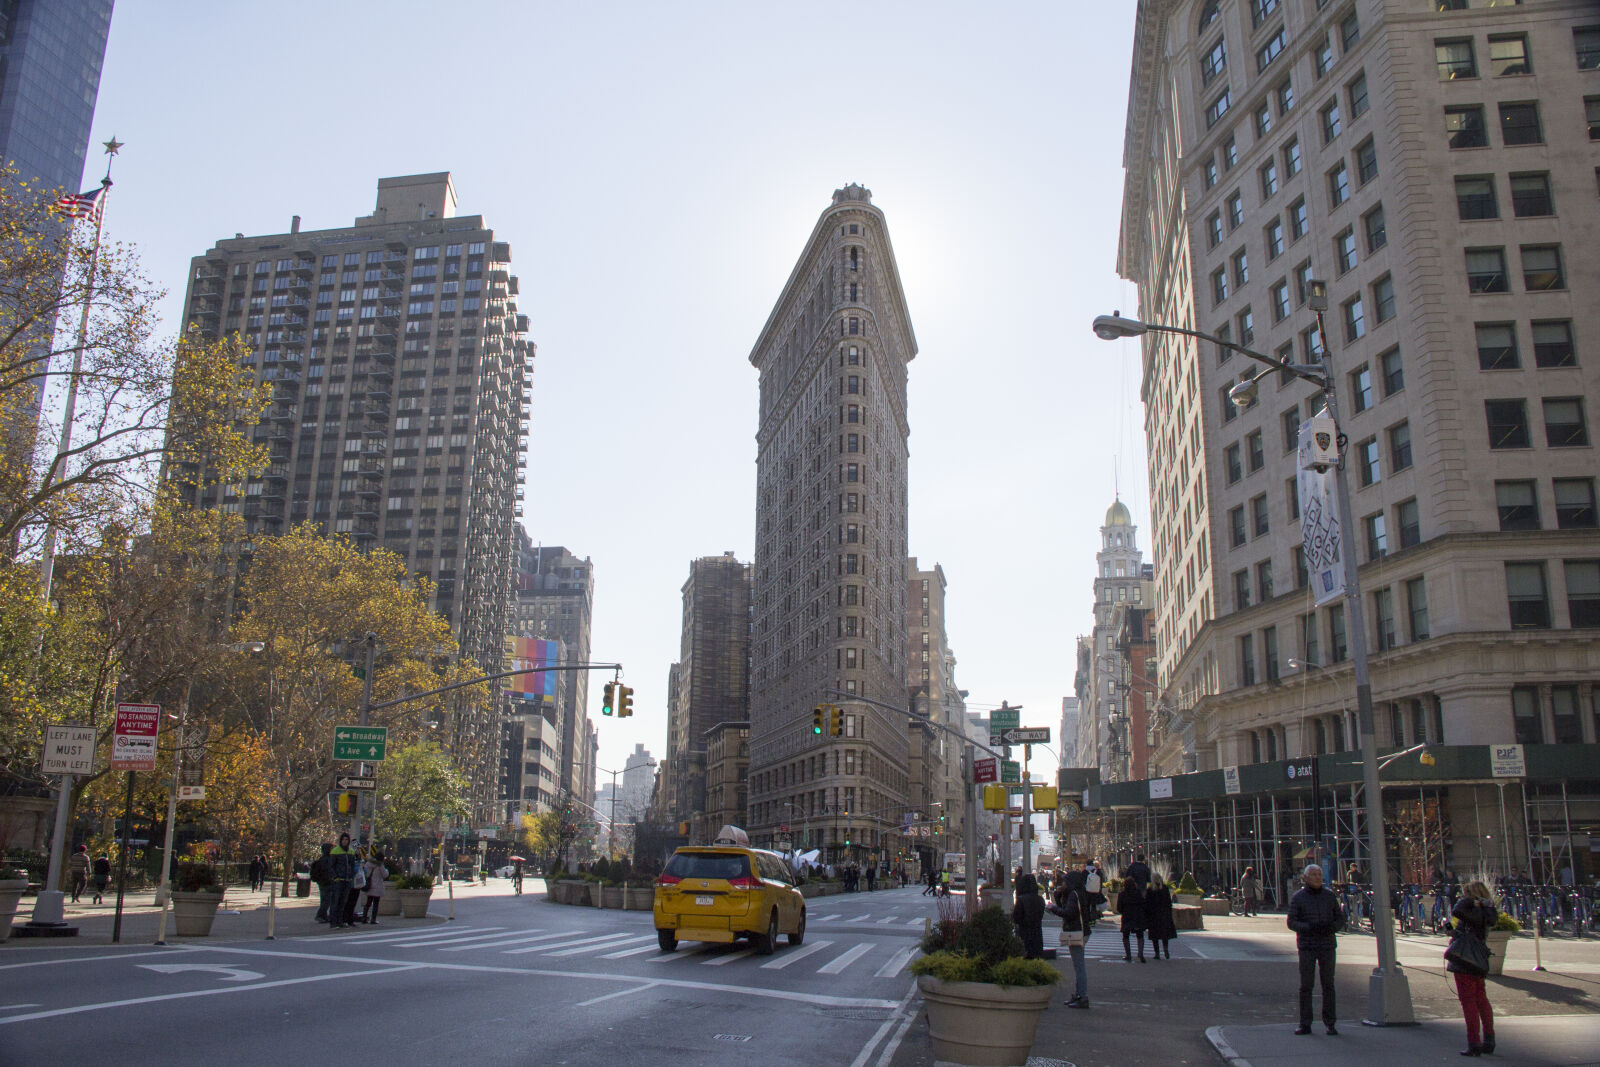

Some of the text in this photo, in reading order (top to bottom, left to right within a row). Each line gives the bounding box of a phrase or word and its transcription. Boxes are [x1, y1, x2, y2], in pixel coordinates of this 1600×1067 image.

[128, 713, 157, 721] STANDING
[50, 731, 93, 741] LEFT LANE
[352, 732, 385, 742] Broadway
[1008, 732, 1022, 740] ONE
[56, 745, 82, 755] MUST
[347, 747, 360, 755] Ave
[47, 760, 90, 769] TURN LEFT
[1297, 765, 1312, 777] at&t
